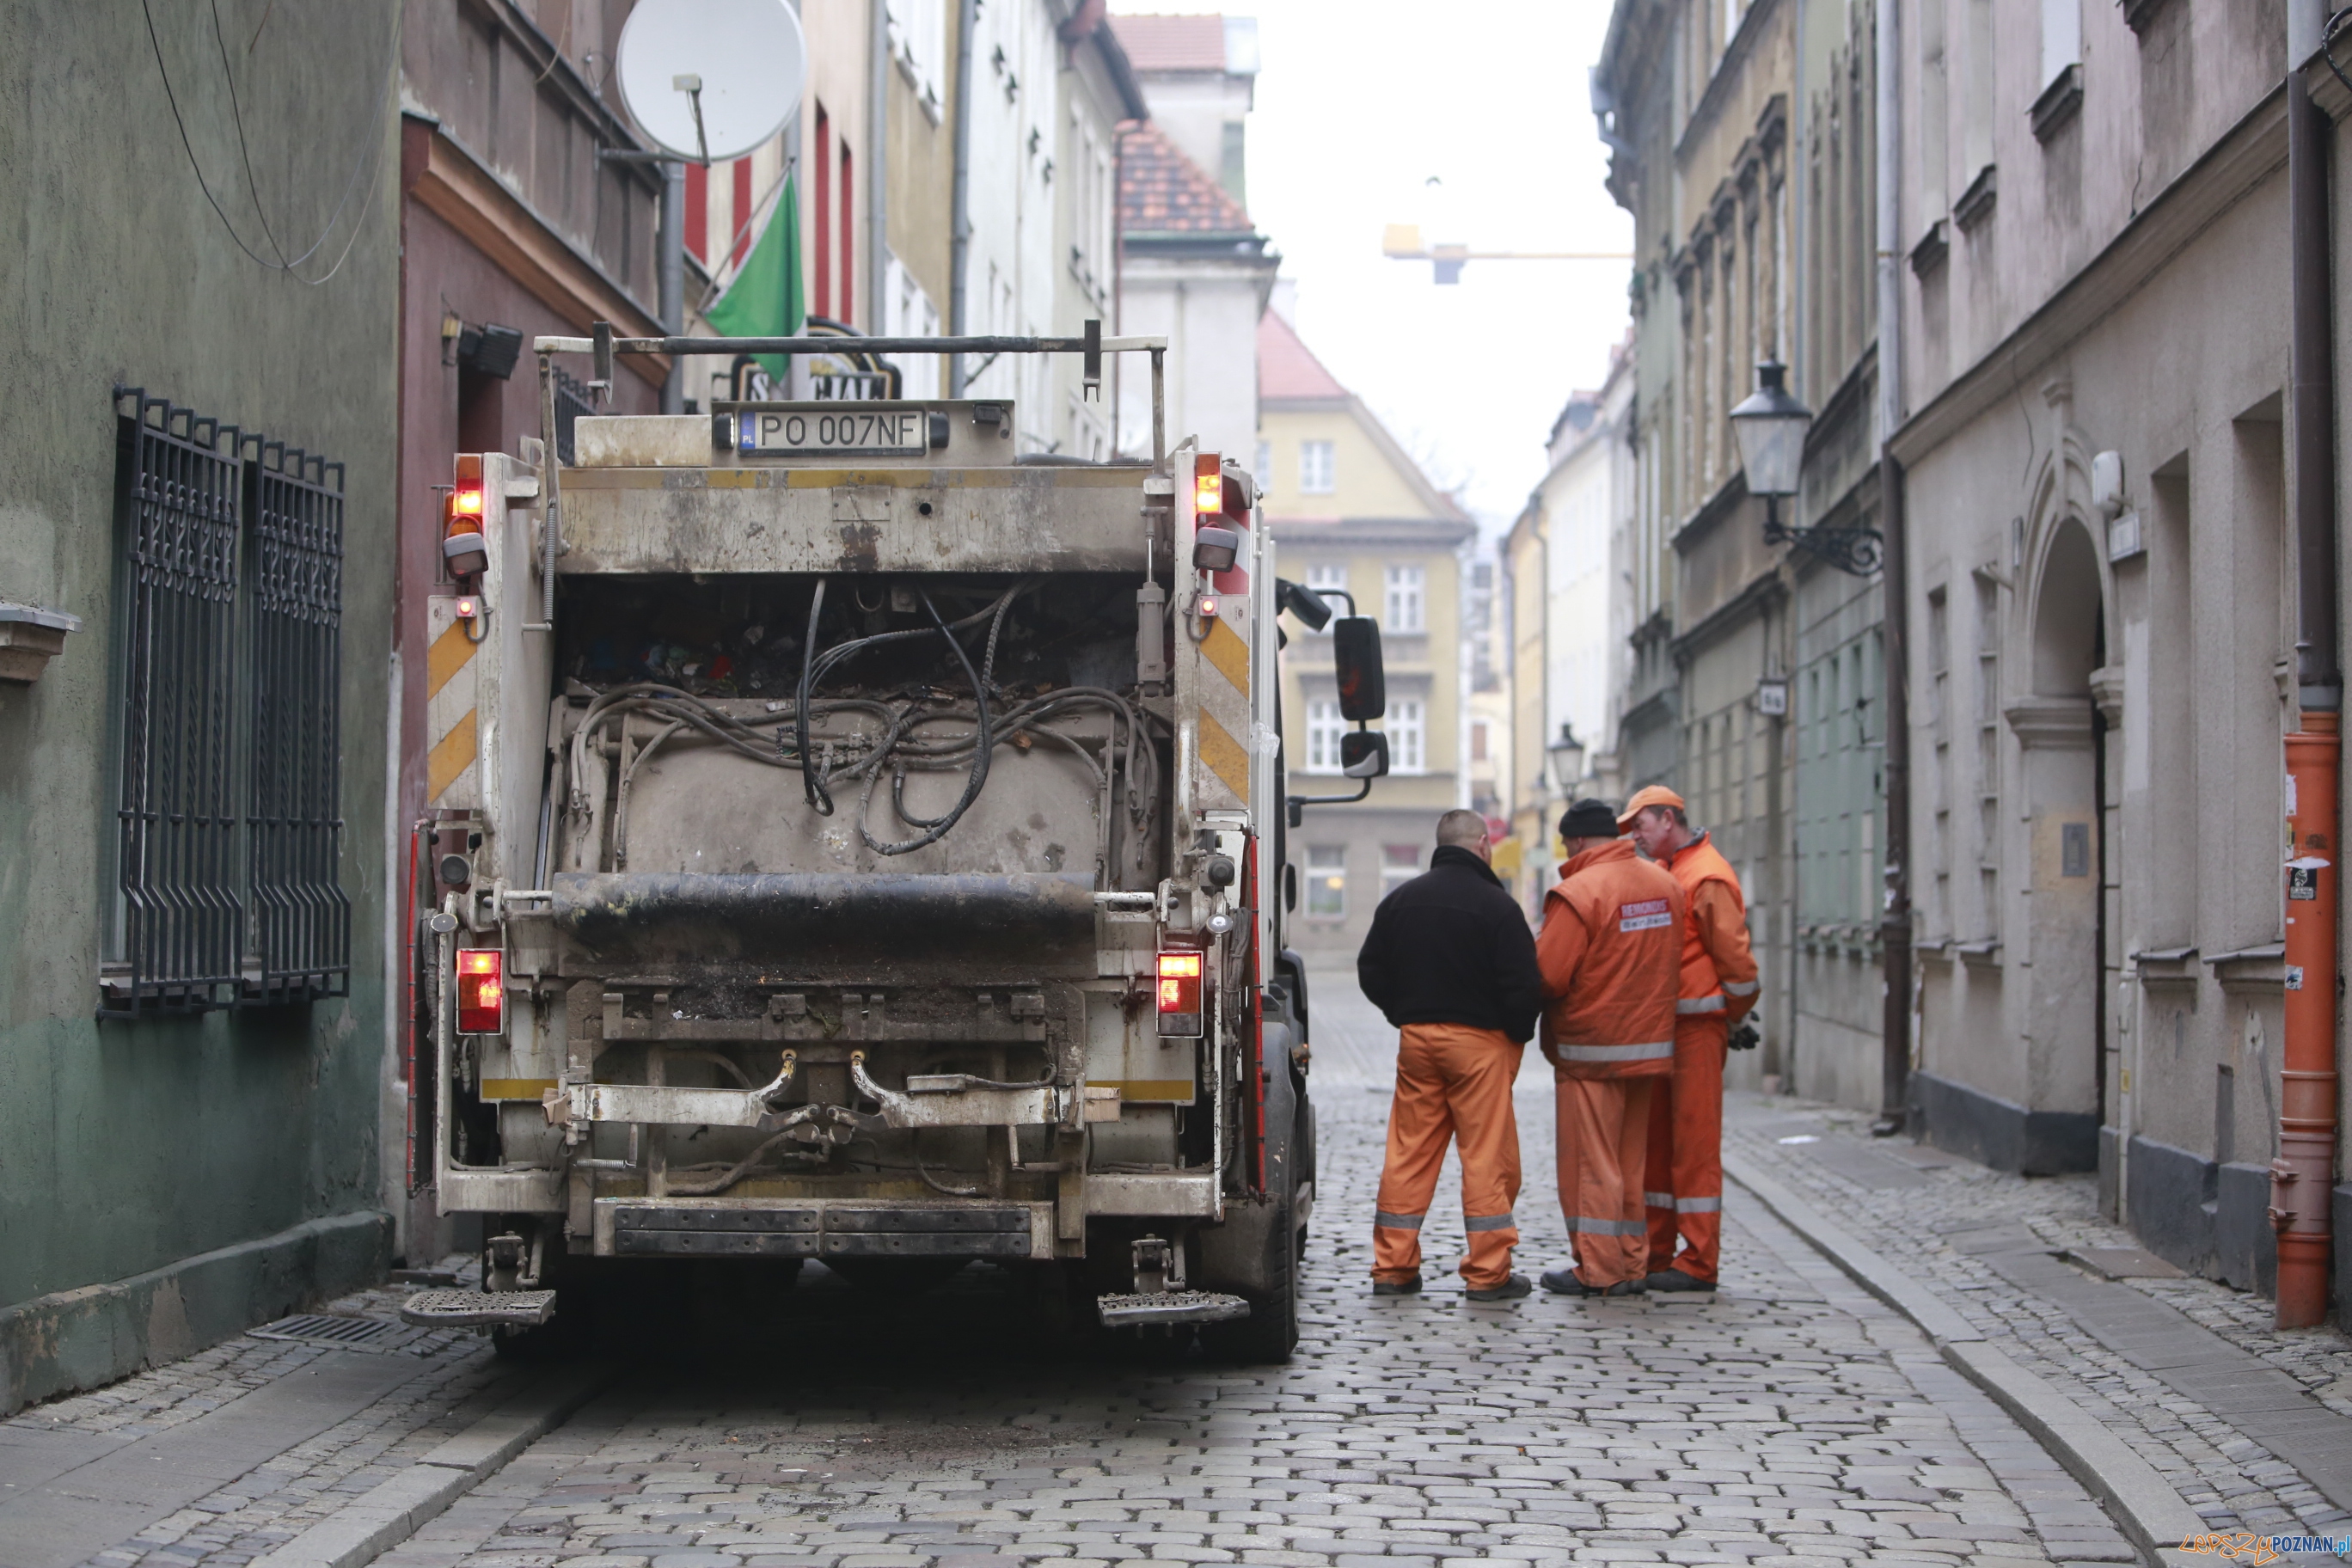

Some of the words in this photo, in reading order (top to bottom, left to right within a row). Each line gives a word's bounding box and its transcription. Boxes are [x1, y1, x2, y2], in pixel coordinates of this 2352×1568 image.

[743, 435, 754, 444] PL
[761, 415, 805, 445] PO
[819, 415, 917, 445] 007NF
